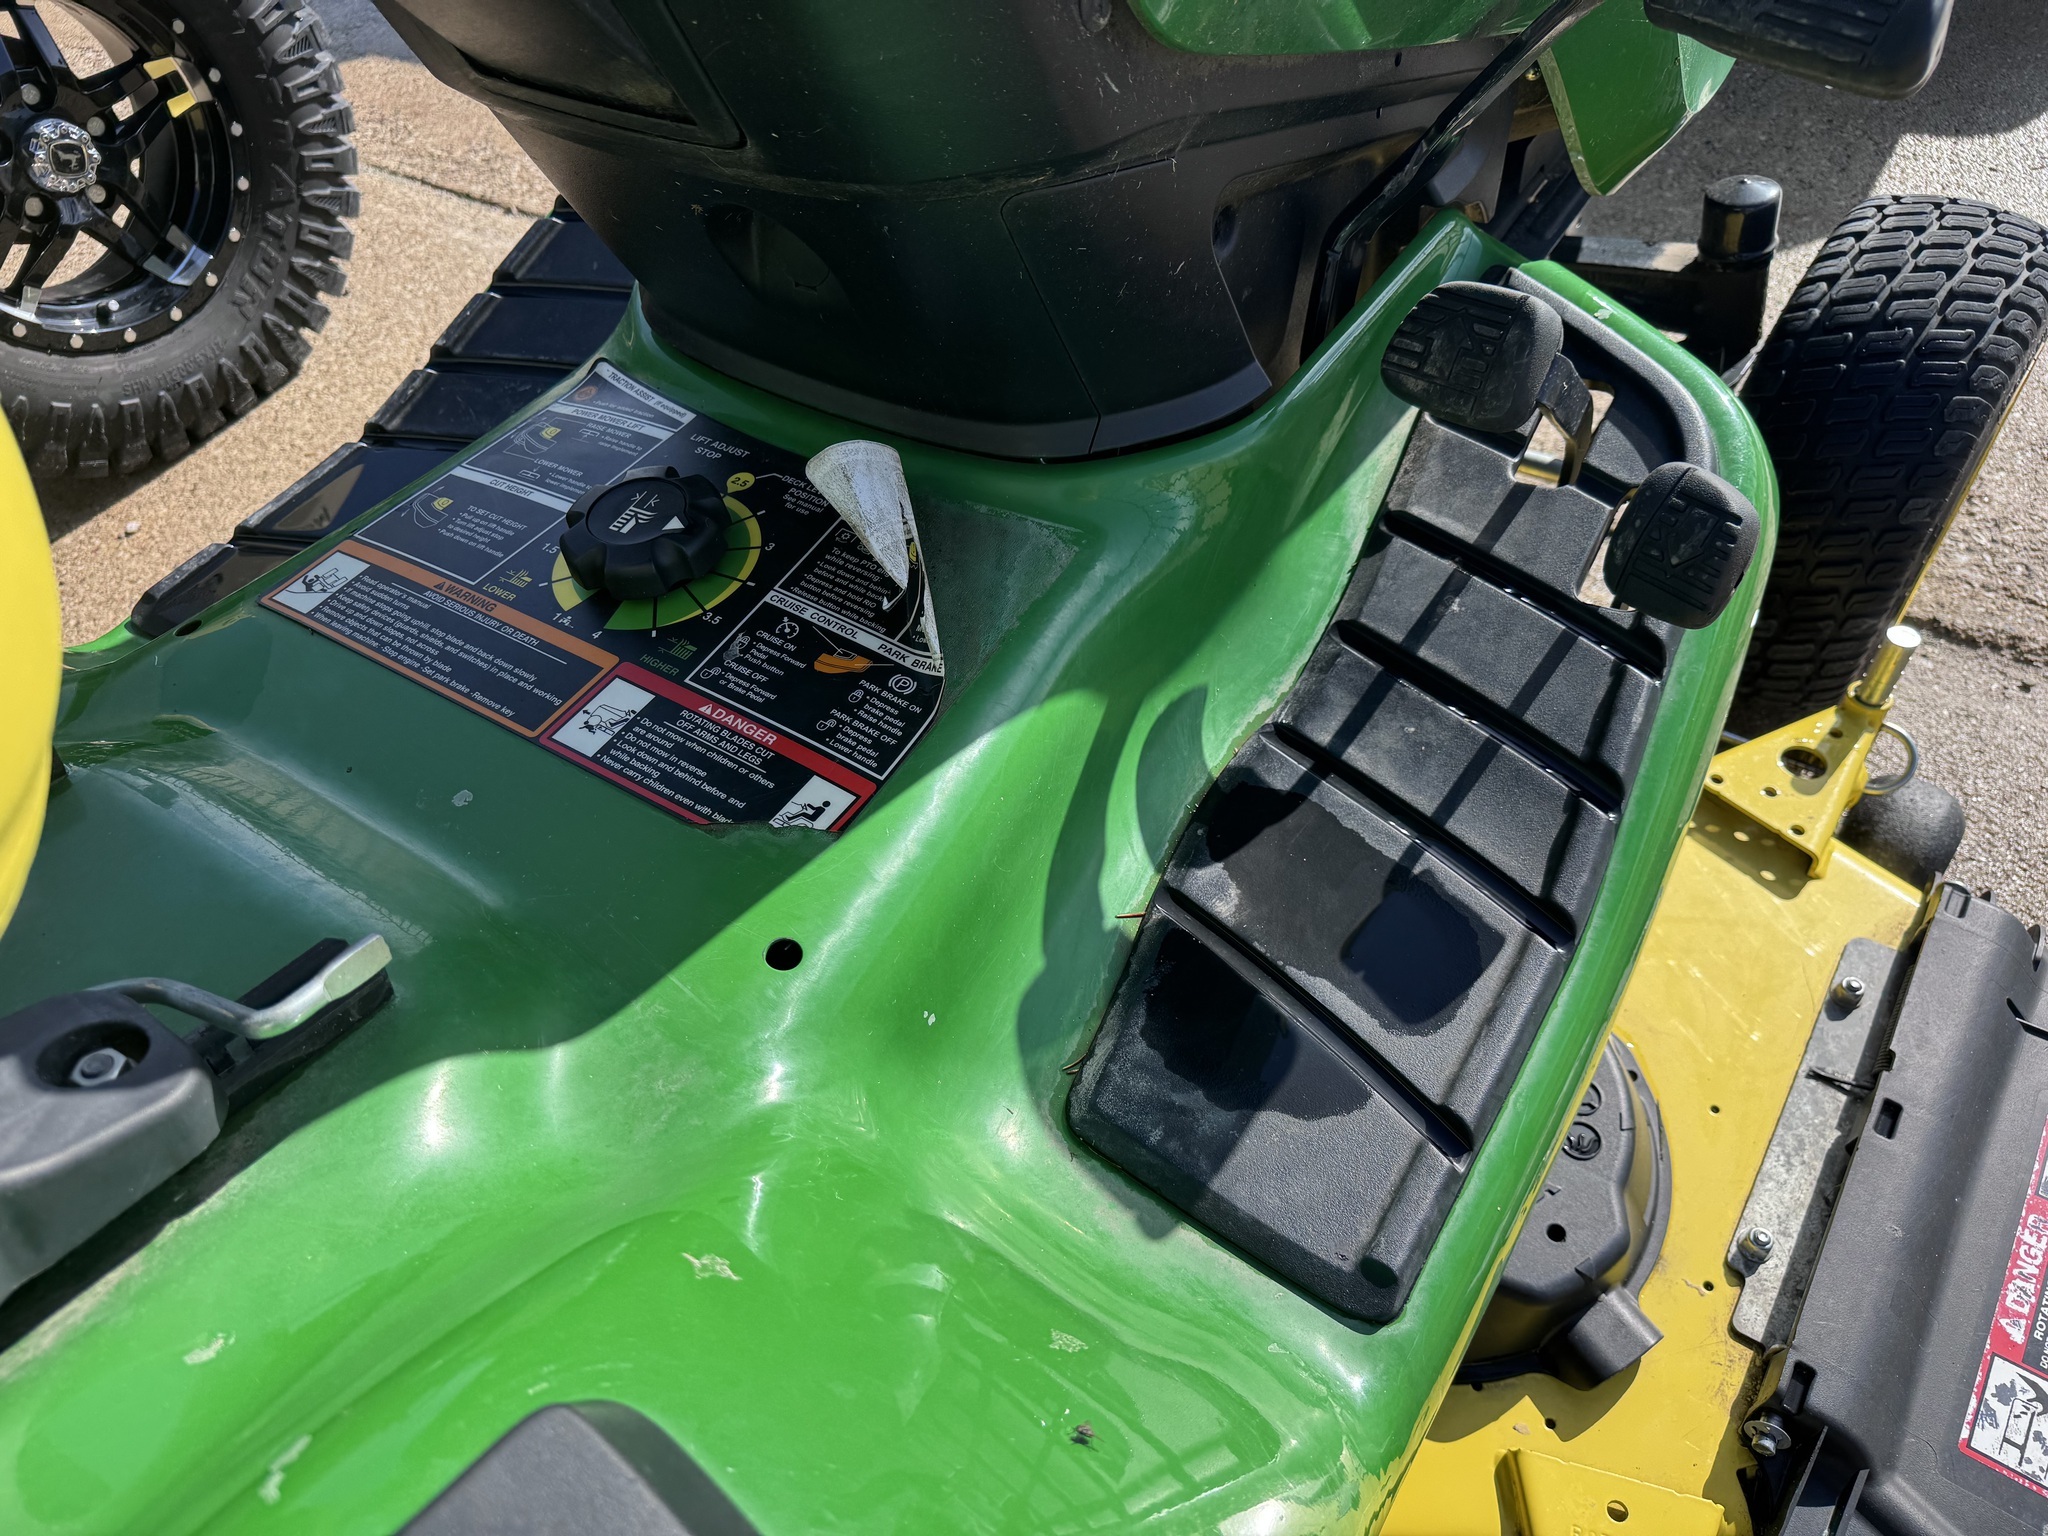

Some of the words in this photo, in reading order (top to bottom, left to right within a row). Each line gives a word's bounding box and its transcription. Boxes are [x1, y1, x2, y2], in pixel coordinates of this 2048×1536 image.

[608, 371, 637, 392] TRACTION
[633, 388, 656, 403] ASSIST
[571, 408, 599, 419] POWER
[598, 414, 628, 428] MOWER
[626, 421, 646, 432] LIFT
[586, 422, 608, 433] RAISE
[606, 428, 632, 439] MOWER
[690, 433, 713, 445] LIFT
[710, 441, 751, 458] ADJUST
[694, 446, 722, 459] STOP
[534, 458, 559, 470] LOWER
[557, 465, 584, 478] MOWER
[490, 479, 507, 489] CUT
[504, 483, 535, 497] HEIGHT
[731, 476, 750, 488] 2.5
[781, 475, 808, 489] DECK
[782, 493, 797, 503] See
[796, 500, 824, 513] manual
[788, 487, 831, 507] POSITION
[795, 507, 809, 515] use
[542, 542, 561, 554] 1.5
[765, 542, 776, 551] 3
[825, 554, 845, 565] while
[353, 581, 373, 592] Avoid
[370, 589, 393, 602] sudden
[392, 599, 410, 610] turns
[361, 575, 380, 586] Read
[376, 583, 408, 599] operator's
[406, 596, 432, 609] manual
[444, 584, 498, 613] WARNING
[483, 582, 517, 602] LOWER
[799, 580, 822, 593] button
[821, 589, 843, 602] before
[843, 600, 875, 618] reversing
[423, 590, 446, 603] AVOID
[443, 599, 476, 617] SERIOUS
[473, 613, 502, 628] INJURY
[500, 625, 514, 635] OR
[512, 630, 540, 646] DEATH
[702, 612, 723, 625] 3.5
[792, 586, 818, 602] Release
[818, 598, 841, 612] button
[841, 609, 859, 620] while
[859, 616, 886, 633] backing
[329, 599, 346, 610] Drive
[353, 612, 368, 620] and
[365, 617, 384, 628] down
[382, 625, 405, 640] slopes,
[404, 636, 419, 645] not
[416, 642, 439, 656] across
[350, 590, 376, 604] machine
[374, 601, 393, 612] stops
[390, 610, 411, 622] going
[410, 618, 431, 630] uphill,
[430, 627, 446, 638] stop
[445, 634, 465, 646] blade
[463, 643, 480, 653] and
[476, 649, 495, 661] back
[493, 658, 514, 670] down
[513, 668, 537, 682] slowly
[592, 630, 603, 639] 4
[770, 594, 809, 616] CRUISE
[810, 612, 859, 640] CONTROL
[877, 643, 912, 663] PARK
[911, 657, 943, 674] BRAKE
[756, 630, 785, 646] CRUISE
[783, 642, 797, 651] ON
[640, 653, 680, 677] HIGHER
[743, 653, 762, 665] Push
[761, 662, 784, 676] button
[749, 648, 768, 660] Pedal
[755, 642, 781, 657] Depress
[780, 653, 807, 669] Forward
[723, 659, 753, 676] CRUISE
[751, 672, 769, 682] OFF
[724, 672, 750, 688] Depress
[749, 684, 777, 700] Forward
[727, 682, 746, 694] Brake
[745, 691, 765, 703] Pedal
[858, 679, 882, 694] PARK
[880, 690, 910, 708] BRAKE
[908, 704, 922, 713] ON
[863, 703, 884, 717] brake
[883, 715, 906, 727] pedal
[869, 697, 899, 715] Depress
[679, 709, 721, 733] ROTATING
[720, 729, 756, 750] BLADES
[755, 746, 775, 759] CUT
[712, 708, 778, 746] DANGER
[830, 708, 853, 723] PARK
[851, 719, 881, 738] BRAKE
[880, 734, 898, 745] OFF
[842, 725, 872, 744] Depress
[857, 709, 878, 723] Raise
[877, 720, 903, 736] handle
[632, 726, 646, 735] are
[645, 732, 675, 749] around
[676, 719, 695, 730] OFF
[692, 728, 719, 744] ARMS
[717, 740, 738, 753] AND
[737, 749, 763, 765] LEGS
[836, 732, 857, 746] brake
[856, 744, 879, 758] pedal
[609, 748, 630, 762] while
[629, 757, 661, 778] backing
[624, 732, 637, 742] Do
[636, 739, 651, 749] not
[649, 746, 670, 758] mow
[668, 754, 678, 763] in
[677, 759, 707, 777] reverse
[640, 717, 653, 727] Do
[651, 724, 667, 734] not
[665, 731, 686, 743] mow
[685, 740, 707, 754] when
[706, 751, 738, 770] children
[748, 772, 775, 789] others
[829, 739, 852, 754] Lower
[851, 750, 878, 768] handle
[600, 755, 624, 770] Never
[622, 767, 644, 781] carry
[642, 778, 675, 797] children
[674, 794, 694, 807] even
[694, 803, 712, 816] with
[616, 740, 637, 754] Look
[636, 751, 659, 764] down
[657, 761, 676, 772] and
[673, 768, 703, 786] behind
[700, 782, 727, 799] before
[727, 797, 746, 808] and
[2005, 1214, 2048, 1316] DANGER
